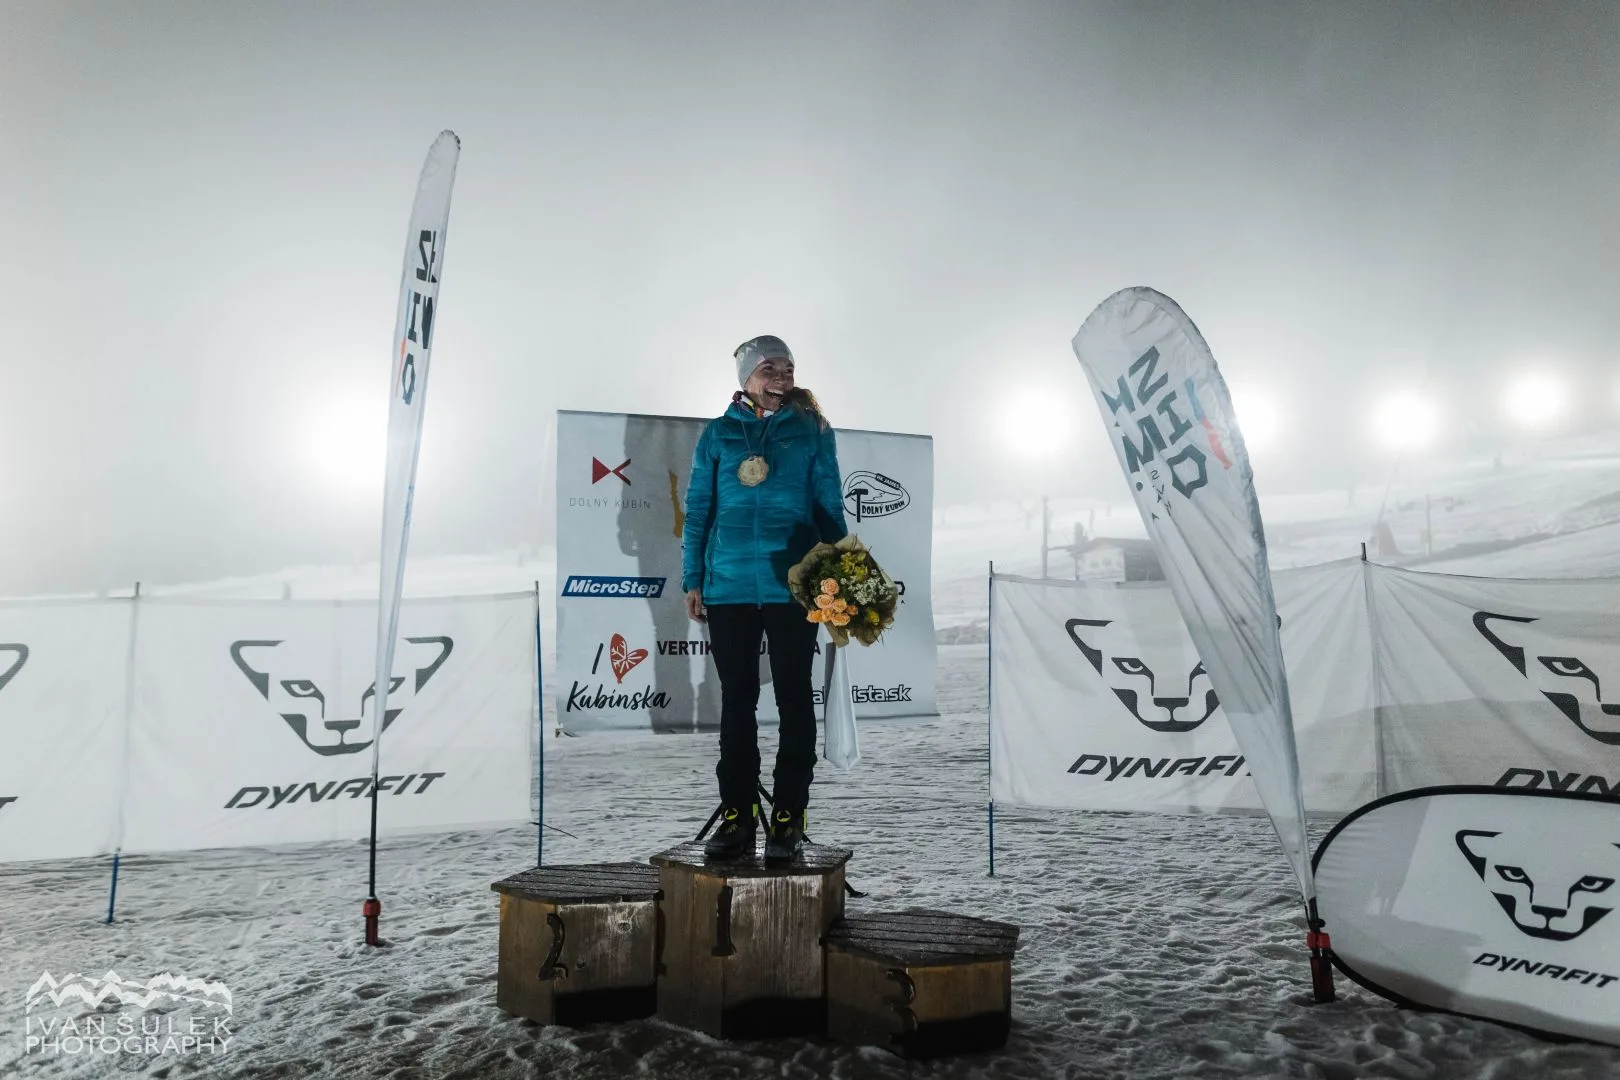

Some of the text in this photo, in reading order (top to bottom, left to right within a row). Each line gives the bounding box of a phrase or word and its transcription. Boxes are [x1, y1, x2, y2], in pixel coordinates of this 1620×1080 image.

[569, 497, 651, 509] DOLNÝ KUBÍN
[567, 579, 660, 597] MicroStep
[1067, 754, 1252, 781] DYNAFI
[223, 772, 446, 809] DYNAFIT
[1472, 953, 1619, 988] DYNAFIT
